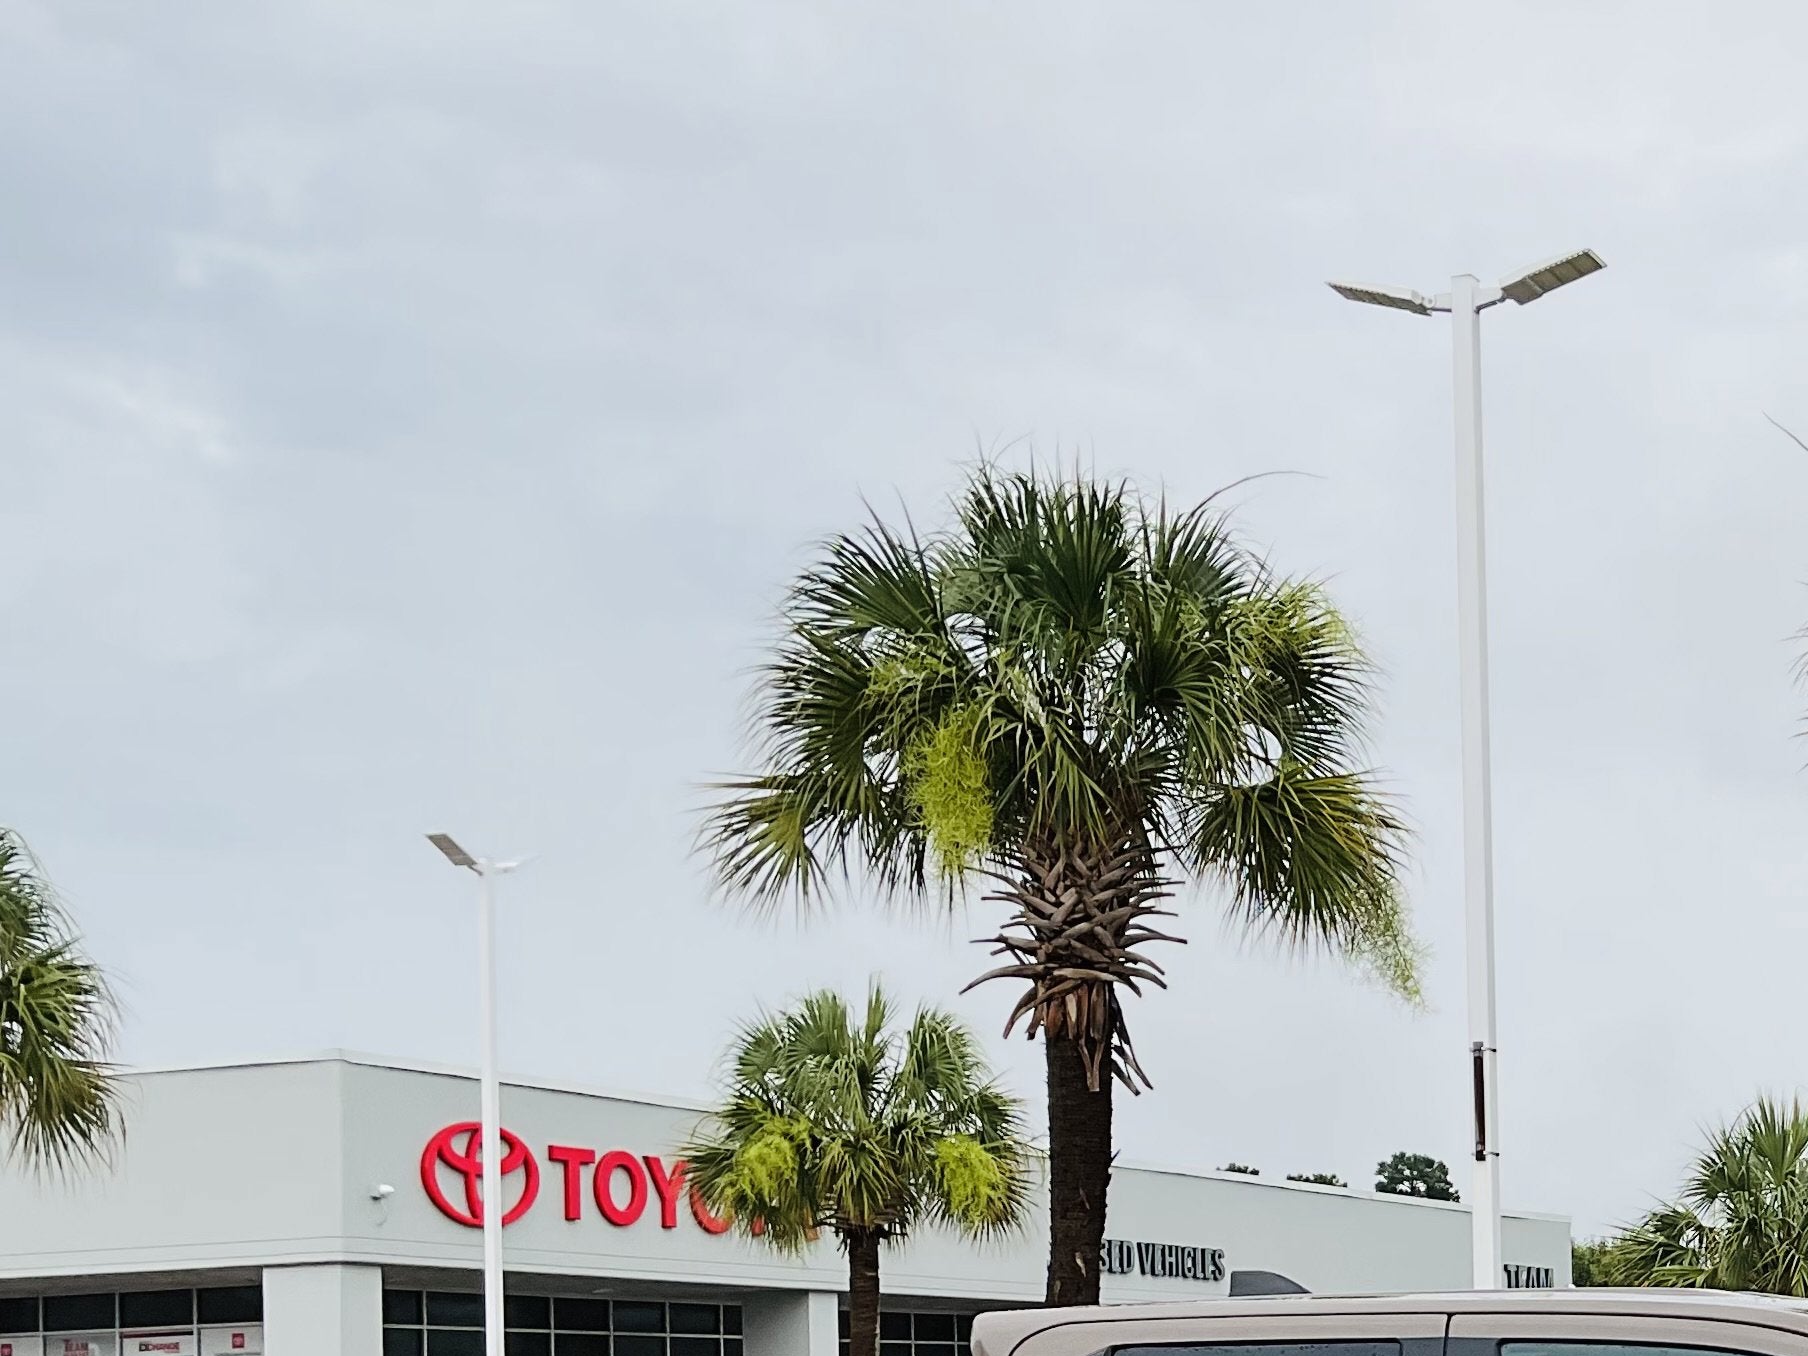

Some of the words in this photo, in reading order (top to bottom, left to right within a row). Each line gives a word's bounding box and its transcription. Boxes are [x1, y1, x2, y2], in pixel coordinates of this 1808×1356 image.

[548, 1144, 819, 1241] TOYO
[1100, 1239, 1135, 1275] SED
[1137, 1241, 1226, 1282] VEHICLES
[1503, 1263, 1554, 1289] TEAM
